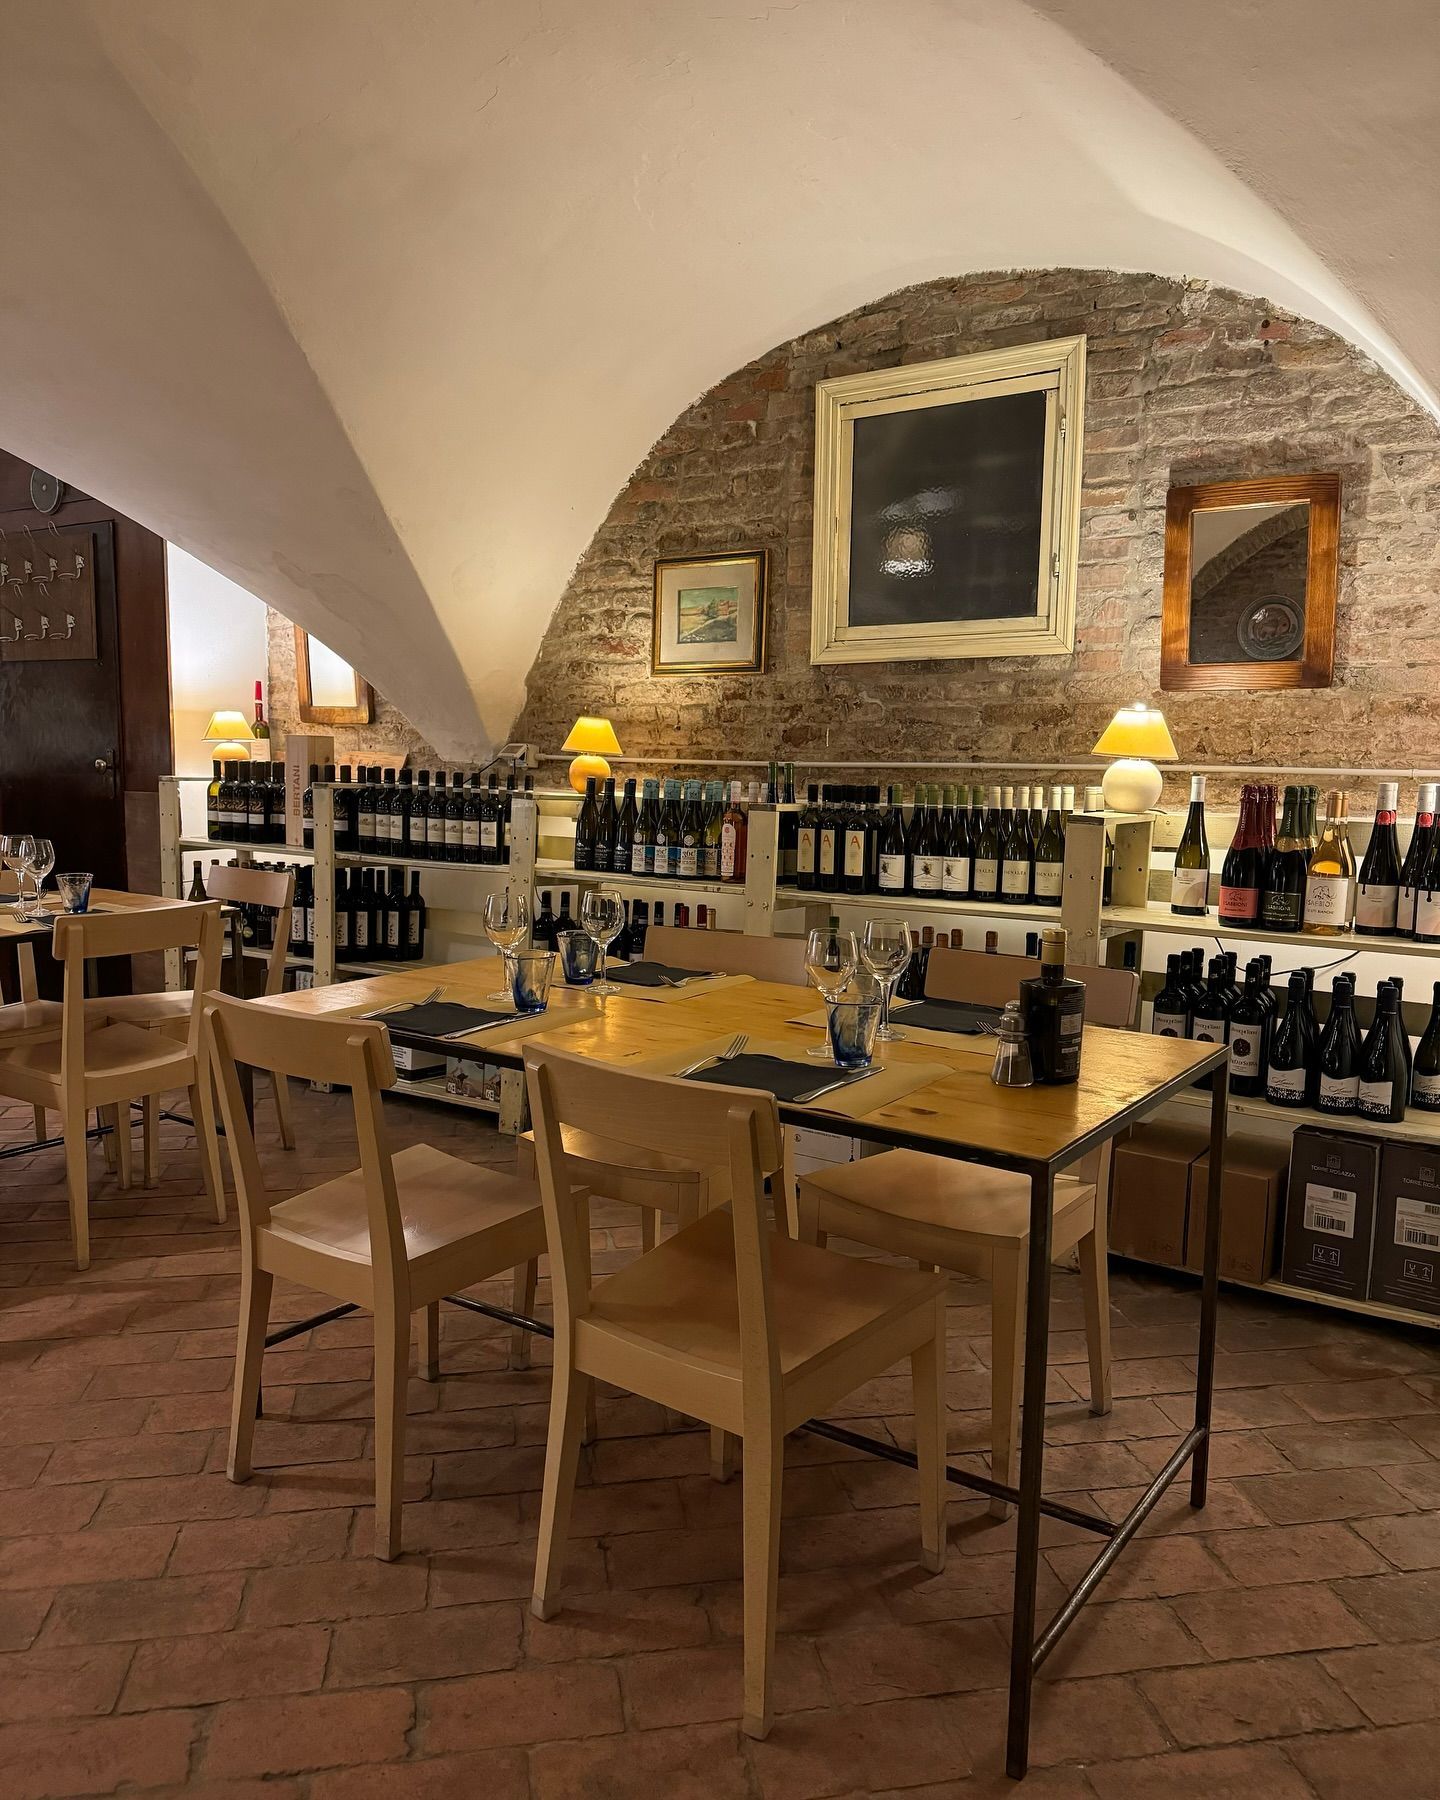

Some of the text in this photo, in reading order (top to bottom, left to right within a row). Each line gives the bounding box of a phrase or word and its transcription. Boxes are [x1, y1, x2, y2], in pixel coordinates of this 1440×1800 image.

[802, 832, 811, 847] A
[823, 834, 832, 848] A
[851, 835, 860, 850] A
